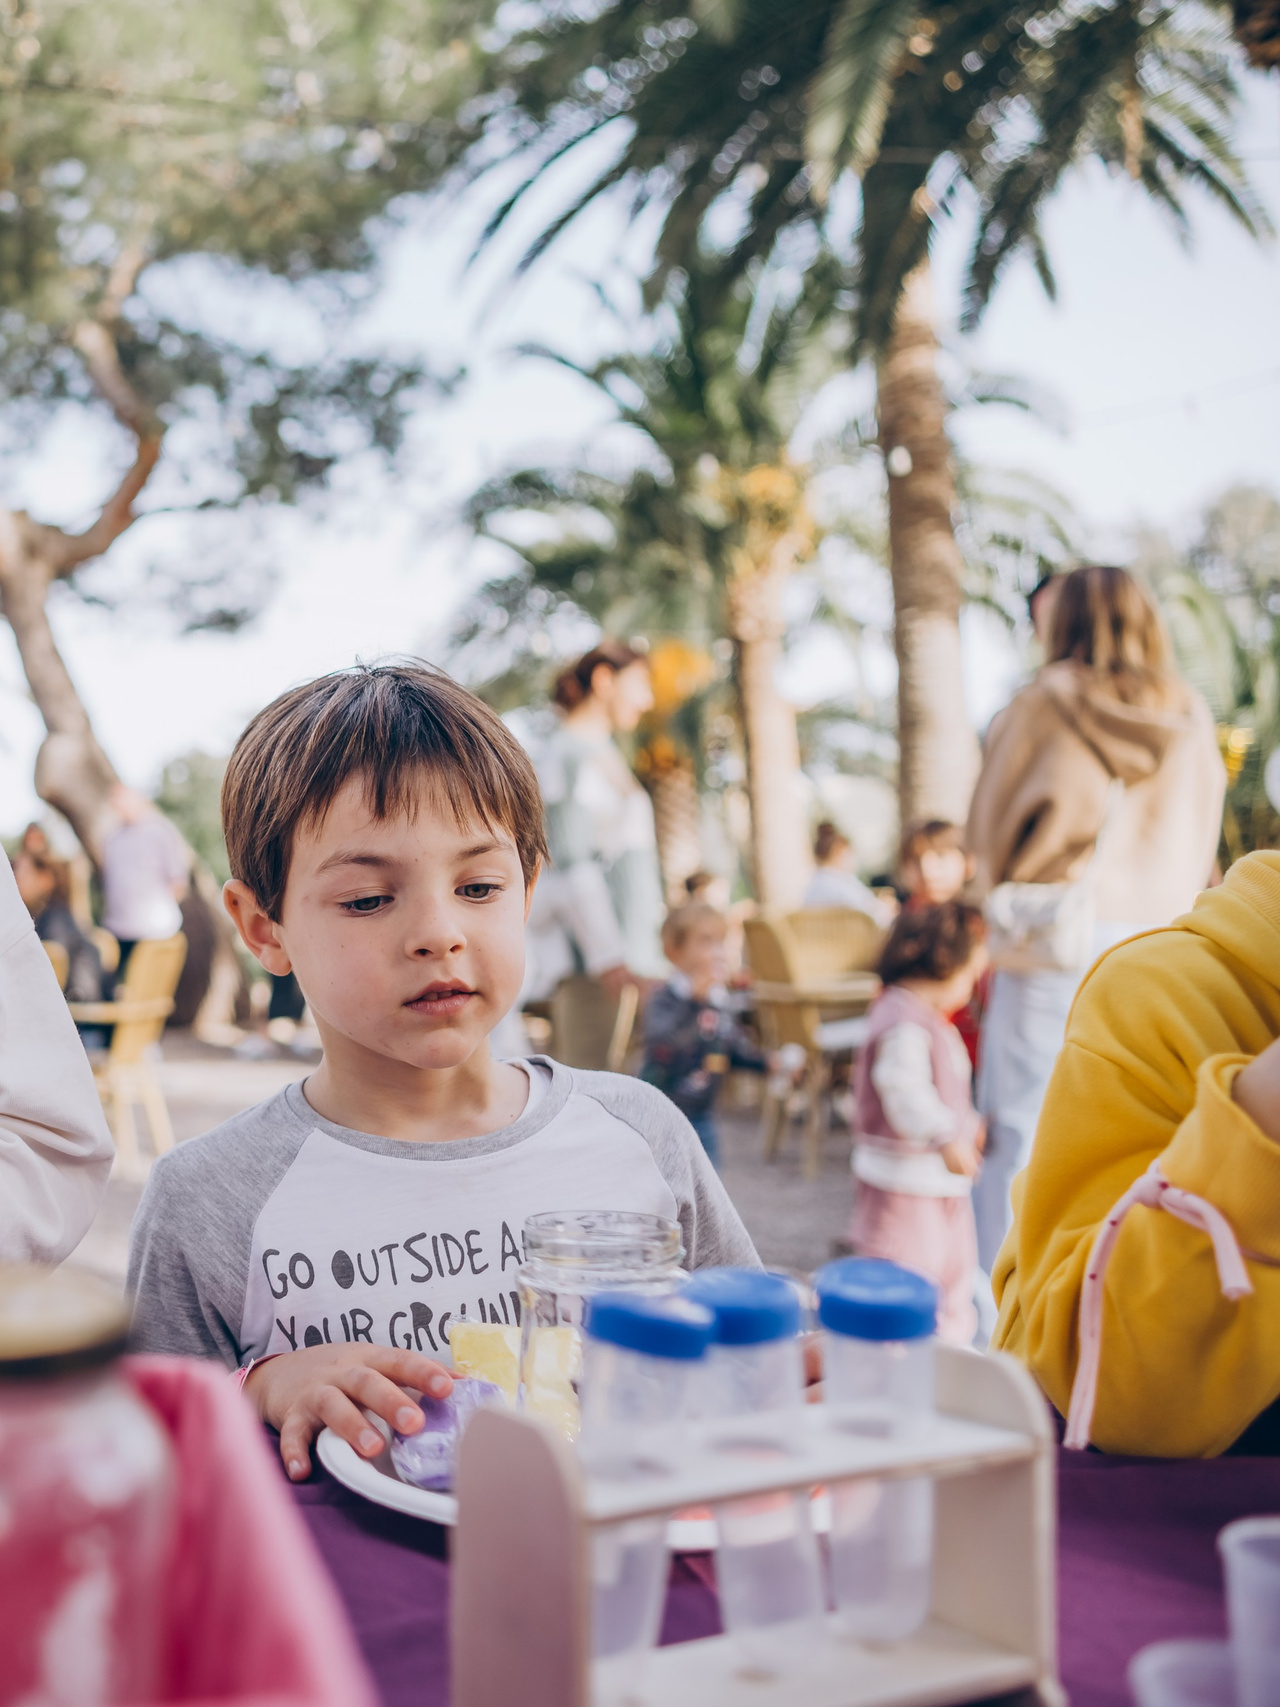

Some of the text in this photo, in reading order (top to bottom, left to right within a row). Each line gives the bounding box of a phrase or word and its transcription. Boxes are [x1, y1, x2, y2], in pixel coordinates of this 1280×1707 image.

[262, 1248, 315, 1299] GO
[331, 1229, 489, 1289] OUTSIDE
[276, 1308, 374, 1351] YOUR
